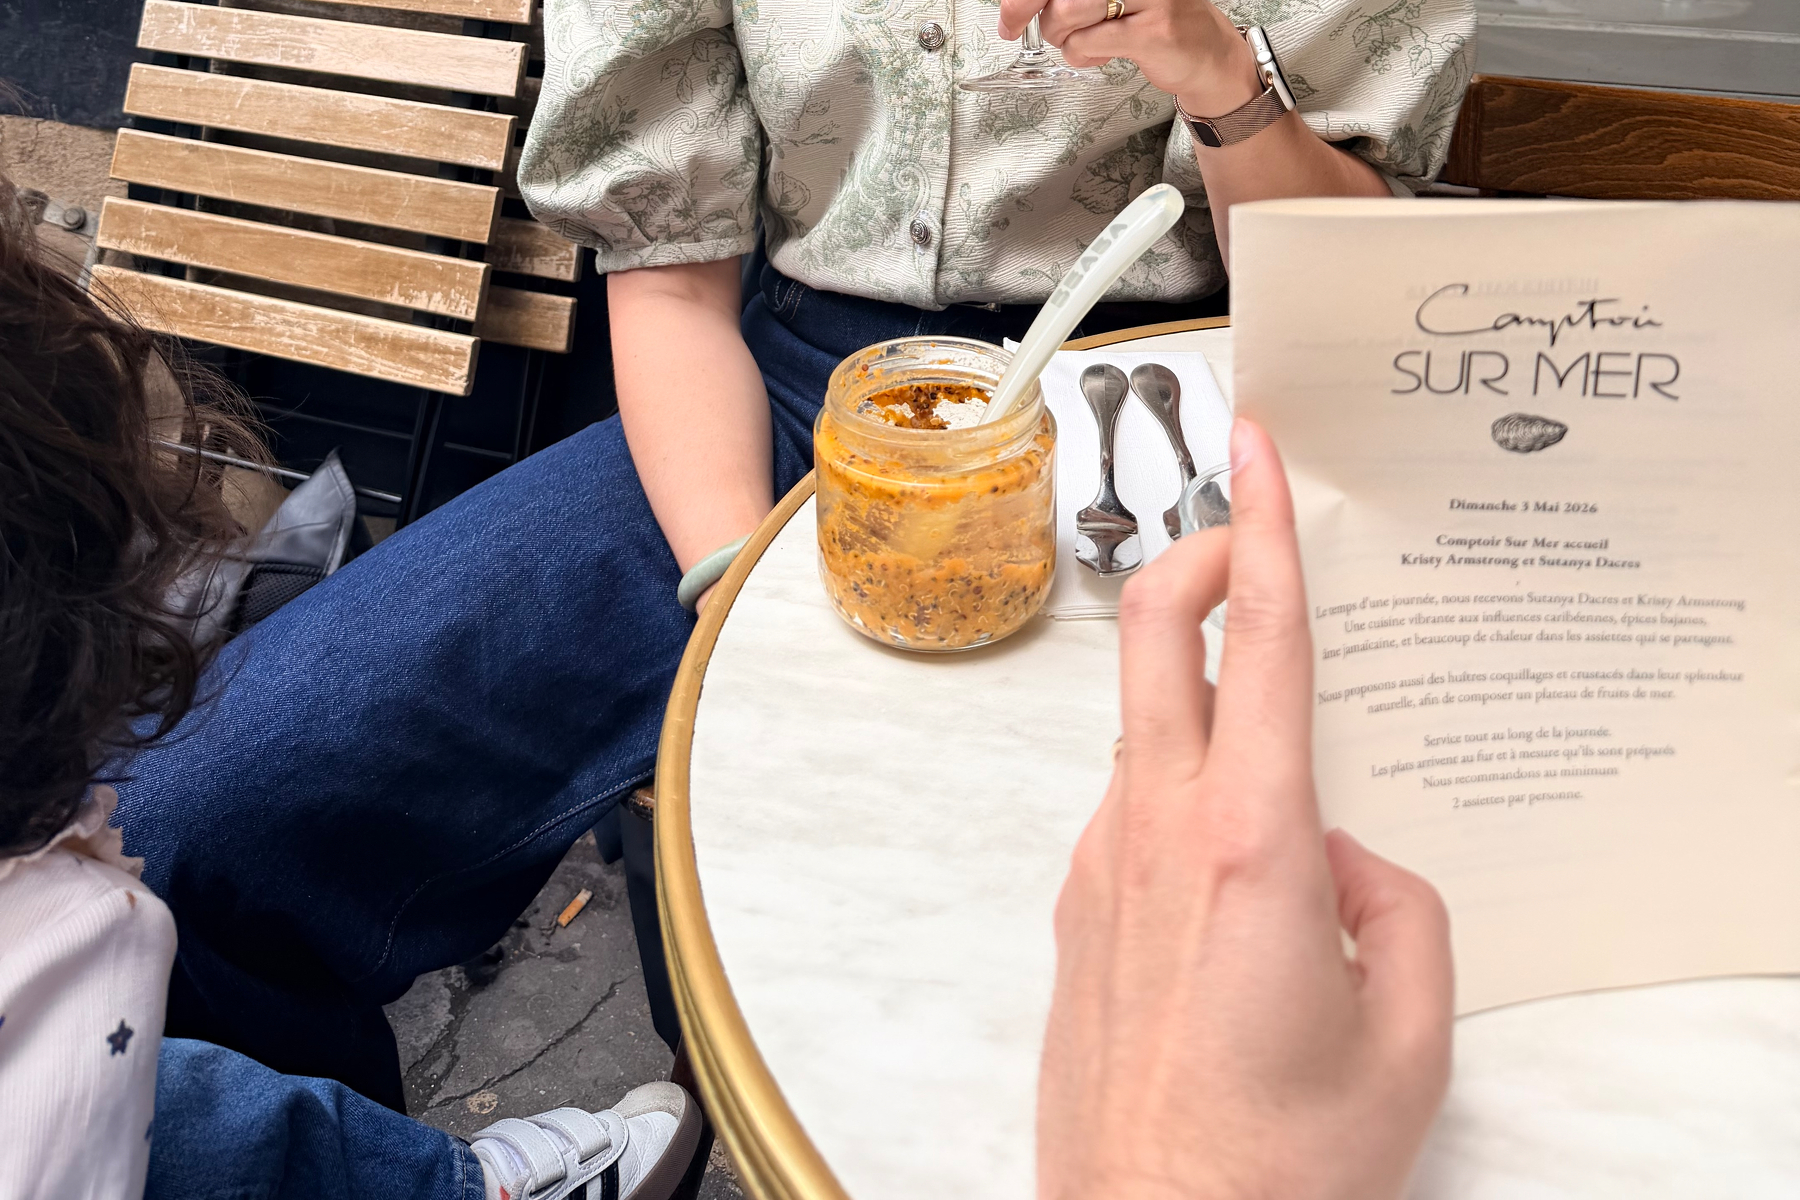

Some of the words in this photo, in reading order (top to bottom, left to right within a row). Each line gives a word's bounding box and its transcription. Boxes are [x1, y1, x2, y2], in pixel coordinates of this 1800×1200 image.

[1391, 350, 1509, 395] SUR
[1532, 351, 1680, 400] MER
[1449, 498, 1517, 512] Dimanche
[1520, 501, 1529, 512] 3
[1533, 500, 1559, 513] Mai
[1563, 502, 1598, 514] 2026
[1435, 534, 1501, 551] Comptoir
[1504, 535, 1528, 548] Sur
[1532, 537, 1559, 549] Mer
[1563, 538, 1609, 550] accueil
[1401, 553, 1441, 568] Kristy
[1446, 553, 1518, 569] Armstrong
[1522, 556, 1535, 567] et
[1538, 554, 1591, 570] Sutanya
[1595, 556, 1641, 569] Dacres
[1315, 606, 1328, 620] Le
[1329, 600, 1357, 616] temps
[1392, 593, 1439, 610] journée,
[1441, 594, 1470, 604] nous
[1473, 593, 1524, 604] recevons
[1527, 592, 1574, 607] Sutanya
[1578, 592, 1618, 605] Dacres
[1621, 595, 1634, 605] et
[1637, 594, 1673, 609] Kristy
[1344, 620, 1366, 633] Une
[1368, 615, 1405, 630] cuisine
[1408, 613, 1455, 626] vibrante
[1458, 614, 1478, 623] aux
[1482, 610, 1541, 623] influences
[1544, 610, 1618, 625] caribéennes,
[1620, 611, 1657, 627] épices
[1660, 612, 1707, 627] bajanes,
[1322, 647, 1341, 660] âme
[1343, 638, 1398, 659] jamaïcaine,
[1401, 637, 1412, 646] et
[1414, 631, 1470, 646] beaucoup
[1473, 630, 1487, 642] de
[1489, 629, 1533, 642] chaleur
[1536, 629, 1563, 642] dans
[1567, 629, 1581, 642] les
[1585, 630, 1632, 643] assiettes
[1635, 632, 1655, 646] qui
[1659, 634, 1671, 643] se
[1673, 633, 1734, 647] partagent.
[1317, 689, 1342, 706] Nous
[1344, 681, 1396, 698] proposons
[1398, 674, 1424, 689] aussi
[1427, 671, 1445, 686] des
[1448, 670, 1487, 684] huîtres
[1490, 667, 1554, 684] coquillages
[1556, 671, 1568, 680] et
[1570, 668, 1624, 680] crustacés
[1626, 667, 1655, 680] dans
[1657, 668, 1679, 680] leur
[1684, 668, 1744, 684] splendeur
[1367, 695, 1415, 715] naturelle,
[1418, 692, 1439, 707] afin
[1441, 692, 1455, 704] de
[1458, 690, 1513, 705] composer
[1516, 690, 1532, 700] un
[1535, 687, 1577, 704] plateau
[1580, 686, 1594, 699] de
[1597, 686, 1630, 699] fruits
[1632, 686, 1647, 699] de
[1423, 733, 1461, 748] Service
[1464, 732, 1489, 743] tout
[1492, 732, 1504, 742] au
[1507, 726, 1533, 743] long
[1535, 726, 1550, 739] de
[1552, 726, 1562, 738] la
[1563, 725, 1612, 742] journée.
[1371, 763, 1388, 777] Les
[1390, 758, 1414, 777] plats
[1416, 755, 1458, 770] arrivent
[1460, 754, 1474, 764] au
[1476, 749, 1493, 763] fur
[1496, 751, 1507, 761] et
[1510, 748, 1516, 760] à
[1518, 748, 1558, 760] mesure
[1597, 746, 1623, 757] sont
[1422, 775, 1452, 789] Nous
[1455, 767, 1541, 785] recommandons
[1543, 768, 1557, 778] au
[1560, 765, 1619, 777] minimum
[1452, 797, 1459, 809] 2
[1462, 793, 1505, 808] assiettes
[1507, 792, 1526, 805] par
[1529, 789, 1583, 804] personne.
